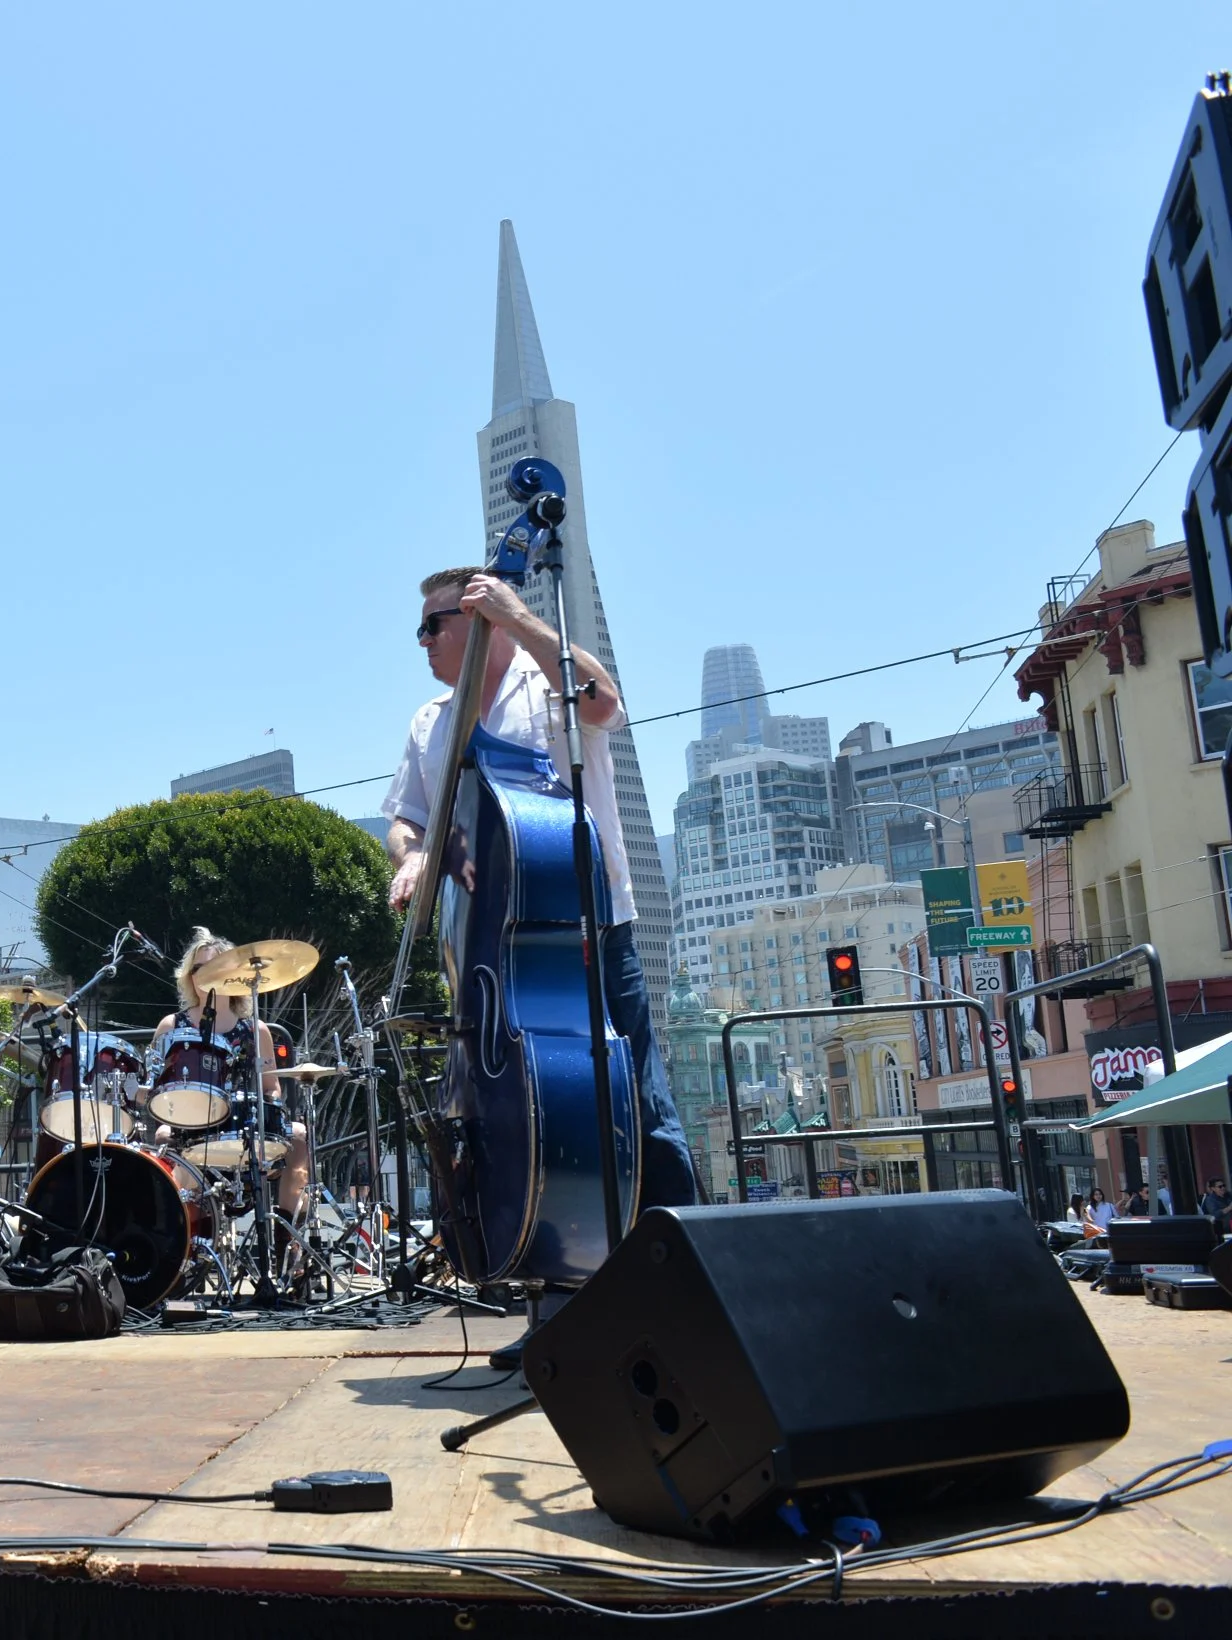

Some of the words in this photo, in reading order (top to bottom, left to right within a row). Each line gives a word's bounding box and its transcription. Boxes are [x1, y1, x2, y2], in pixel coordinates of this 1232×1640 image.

[928, 899, 961, 908] SHAPING
[930, 916, 959, 925] FUTURE
[970, 931, 1016, 942] FREEWAY
[972, 961, 999, 969] SPEED
[975, 976, 1000, 991] 20
[995, 1052, 1011, 1061] RED
